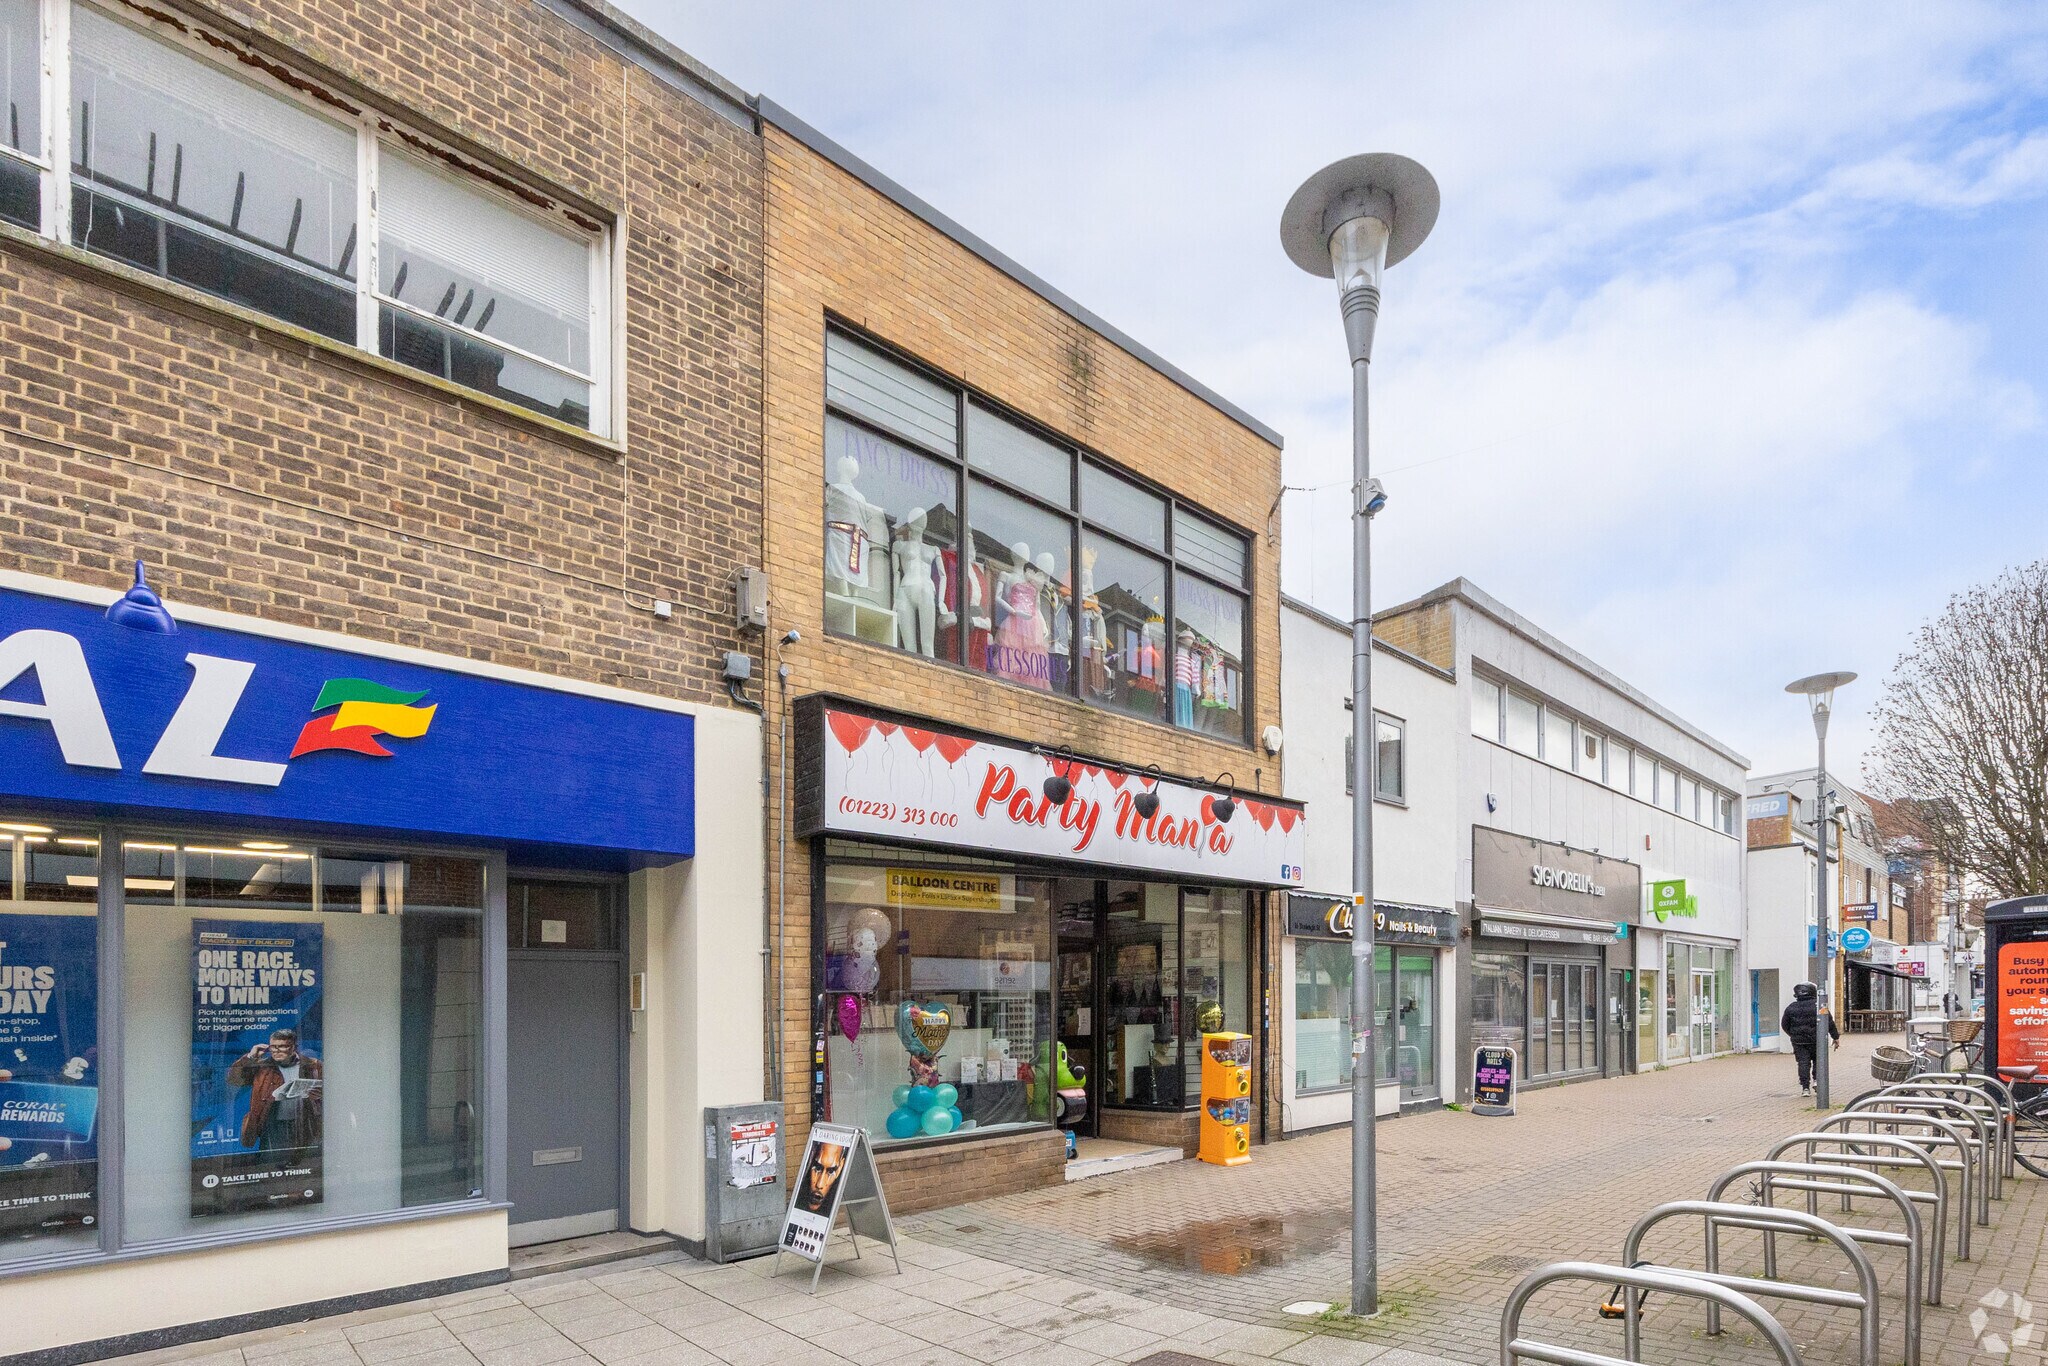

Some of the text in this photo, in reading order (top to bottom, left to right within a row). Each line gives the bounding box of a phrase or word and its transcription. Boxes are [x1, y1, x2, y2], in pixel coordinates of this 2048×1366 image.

[900, 452, 950, 498] DRESS
[984, 644, 1068, 688] ACESSORIES
[838, 794, 959, 829] (01223) 313 000
[973, 760, 1102, 852] Party
[891, 875, 997, 893] BALLOON CENTRE
[891, 890, 917, 899] Displays
[1389, 920, 1438, 937] Nails & Beauty
[1482, 921, 1560, 939] ITALIAN BAKERY & DELICATESSEN
[198, 949, 300, 970] ONE RACE,
[2013, 957, 2045, 967] Busy
[198, 968, 316, 987] MORE WAYS
[198, 986, 270, 1005] TO WIN
[2006, 987, 2036, 997] your
[198, 1008, 217, 1016] Pick
[218, 1009, 253, 1018] multiple
[198, 1024, 211, 1032] for
[212, 1024, 242, 1033] bigger
[927, 1039, 943, 1047] DAY
[3, 1100, 58, 1111] CORAL
[0, 1108, 65, 1123] REWARDS
[221, 1174, 246, 1183] TAKE
[246, 1172, 269, 1180] TIME
[270, 1170, 284, 1178] TO
[284, 1168, 312, 1176] THINK
[12, 1196, 41, 1206] TIME
[41, 1195, 58, 1203] TO
[59, 1191, 92, 1201] THINK
